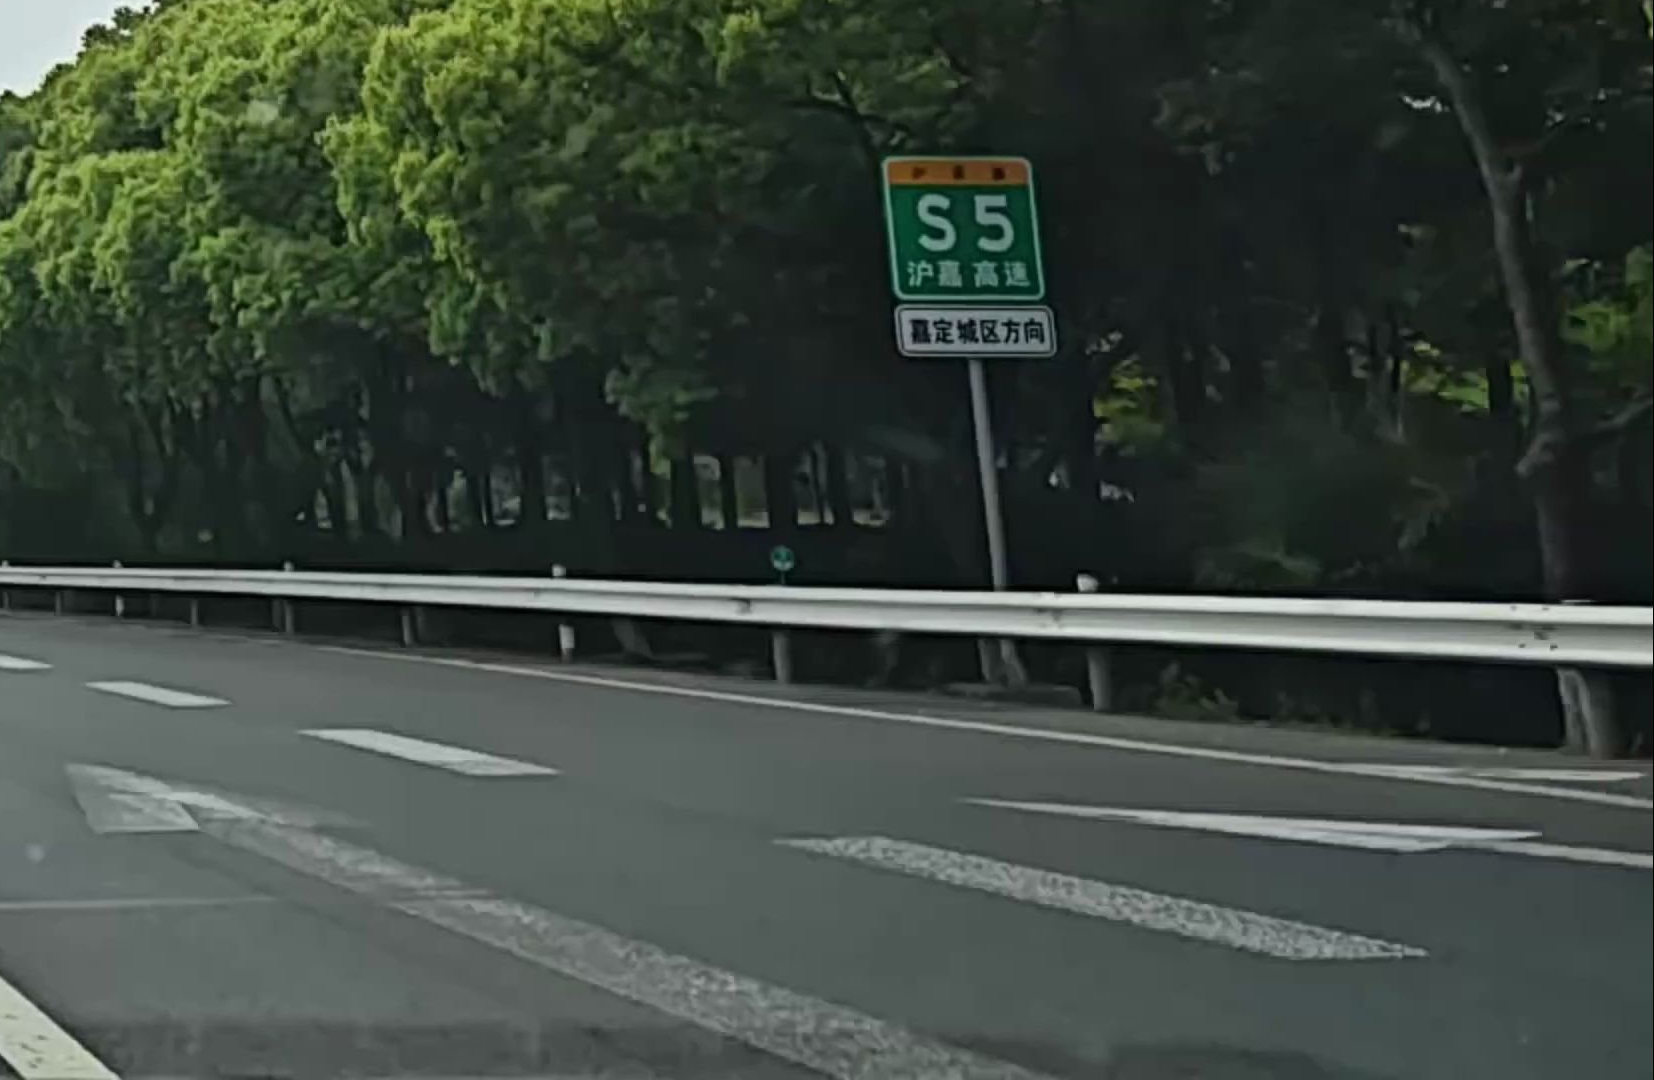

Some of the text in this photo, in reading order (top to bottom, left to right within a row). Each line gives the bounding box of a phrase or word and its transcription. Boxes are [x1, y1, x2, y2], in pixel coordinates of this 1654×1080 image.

[916, 193, 1015, 253] S5
[906, 259, 1031, 288] 沪嘉高速
[909, 317, 1046, 345] 嘉定城区方向
